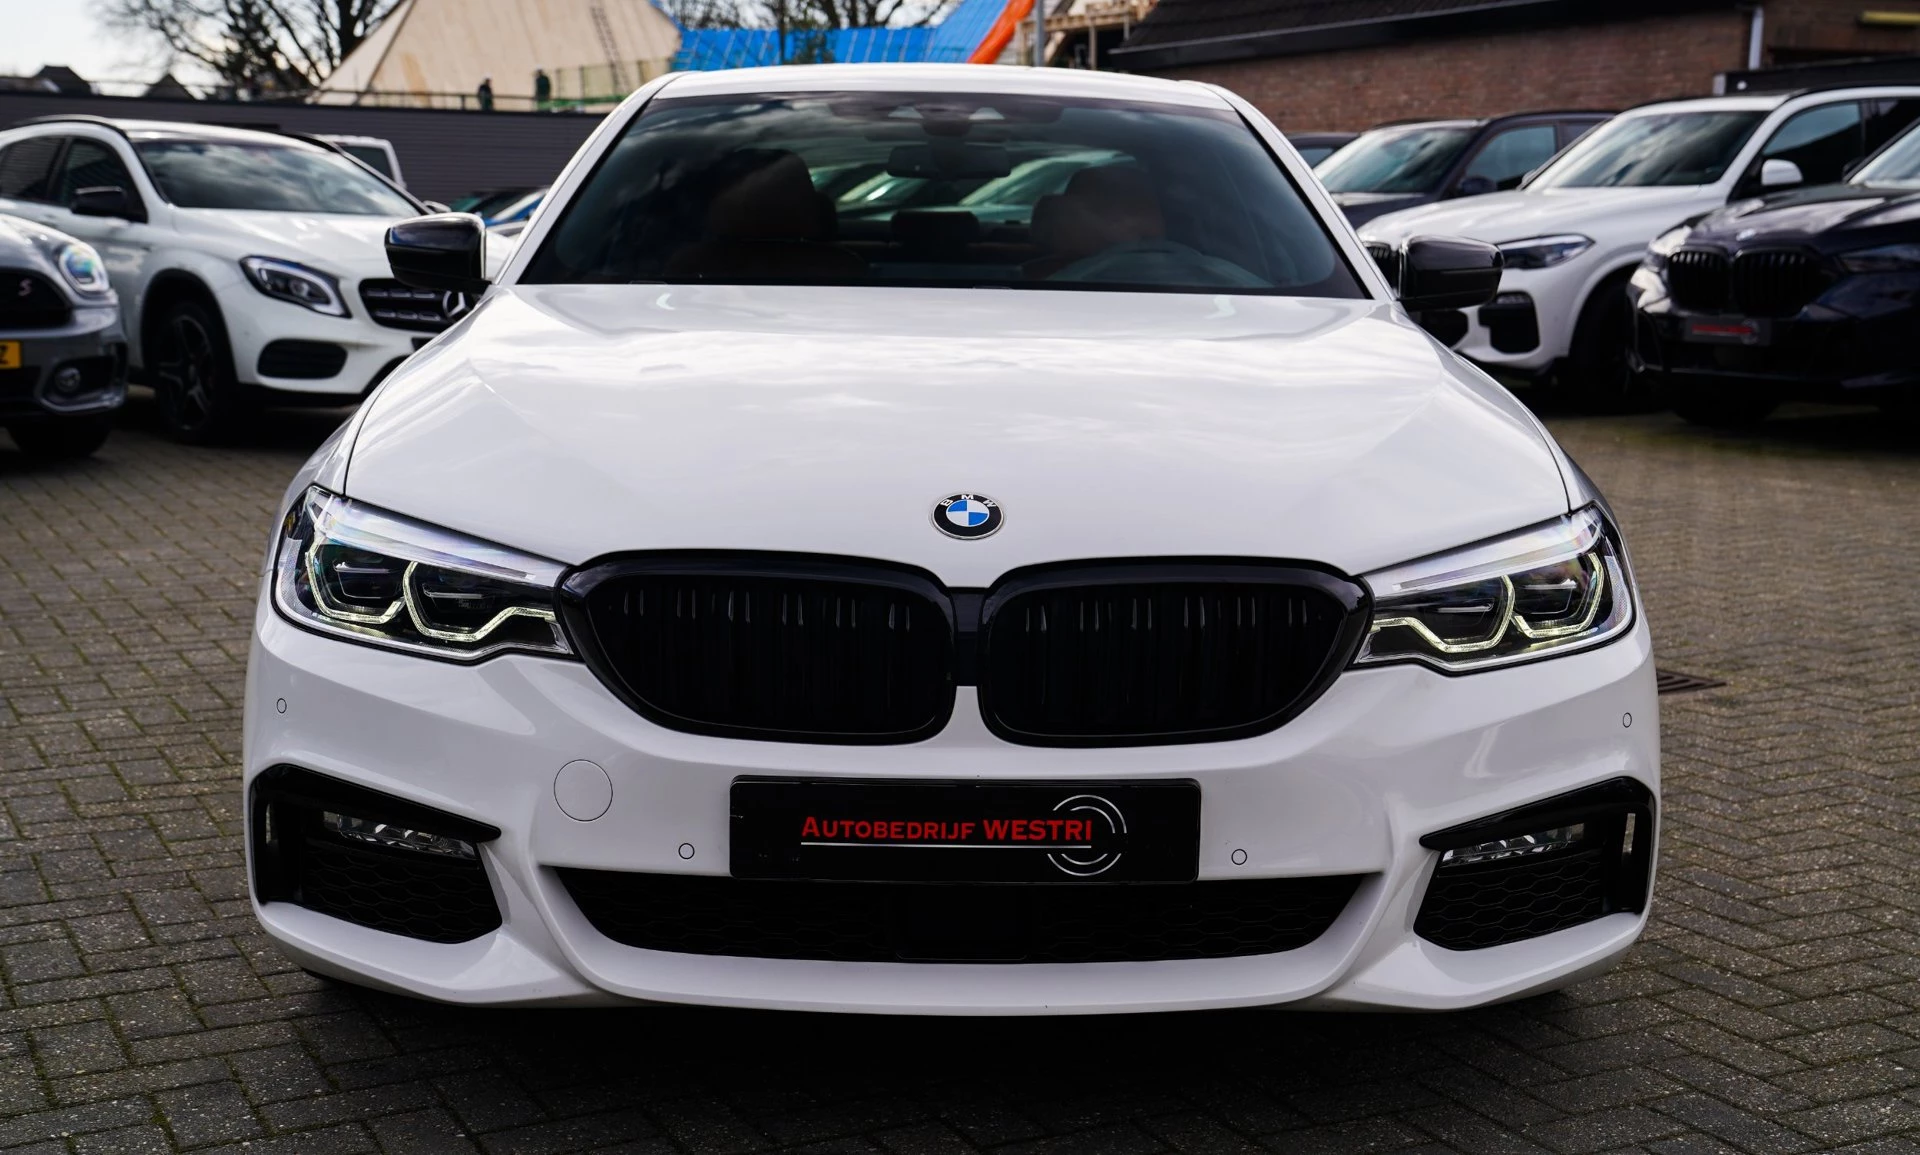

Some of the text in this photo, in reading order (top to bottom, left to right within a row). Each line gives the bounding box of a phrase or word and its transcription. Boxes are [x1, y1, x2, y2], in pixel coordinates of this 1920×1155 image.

[940, 494, 997, 507] BMW
[801, 816, 1092, 841] AUTOBEDRIJF WESTRI
